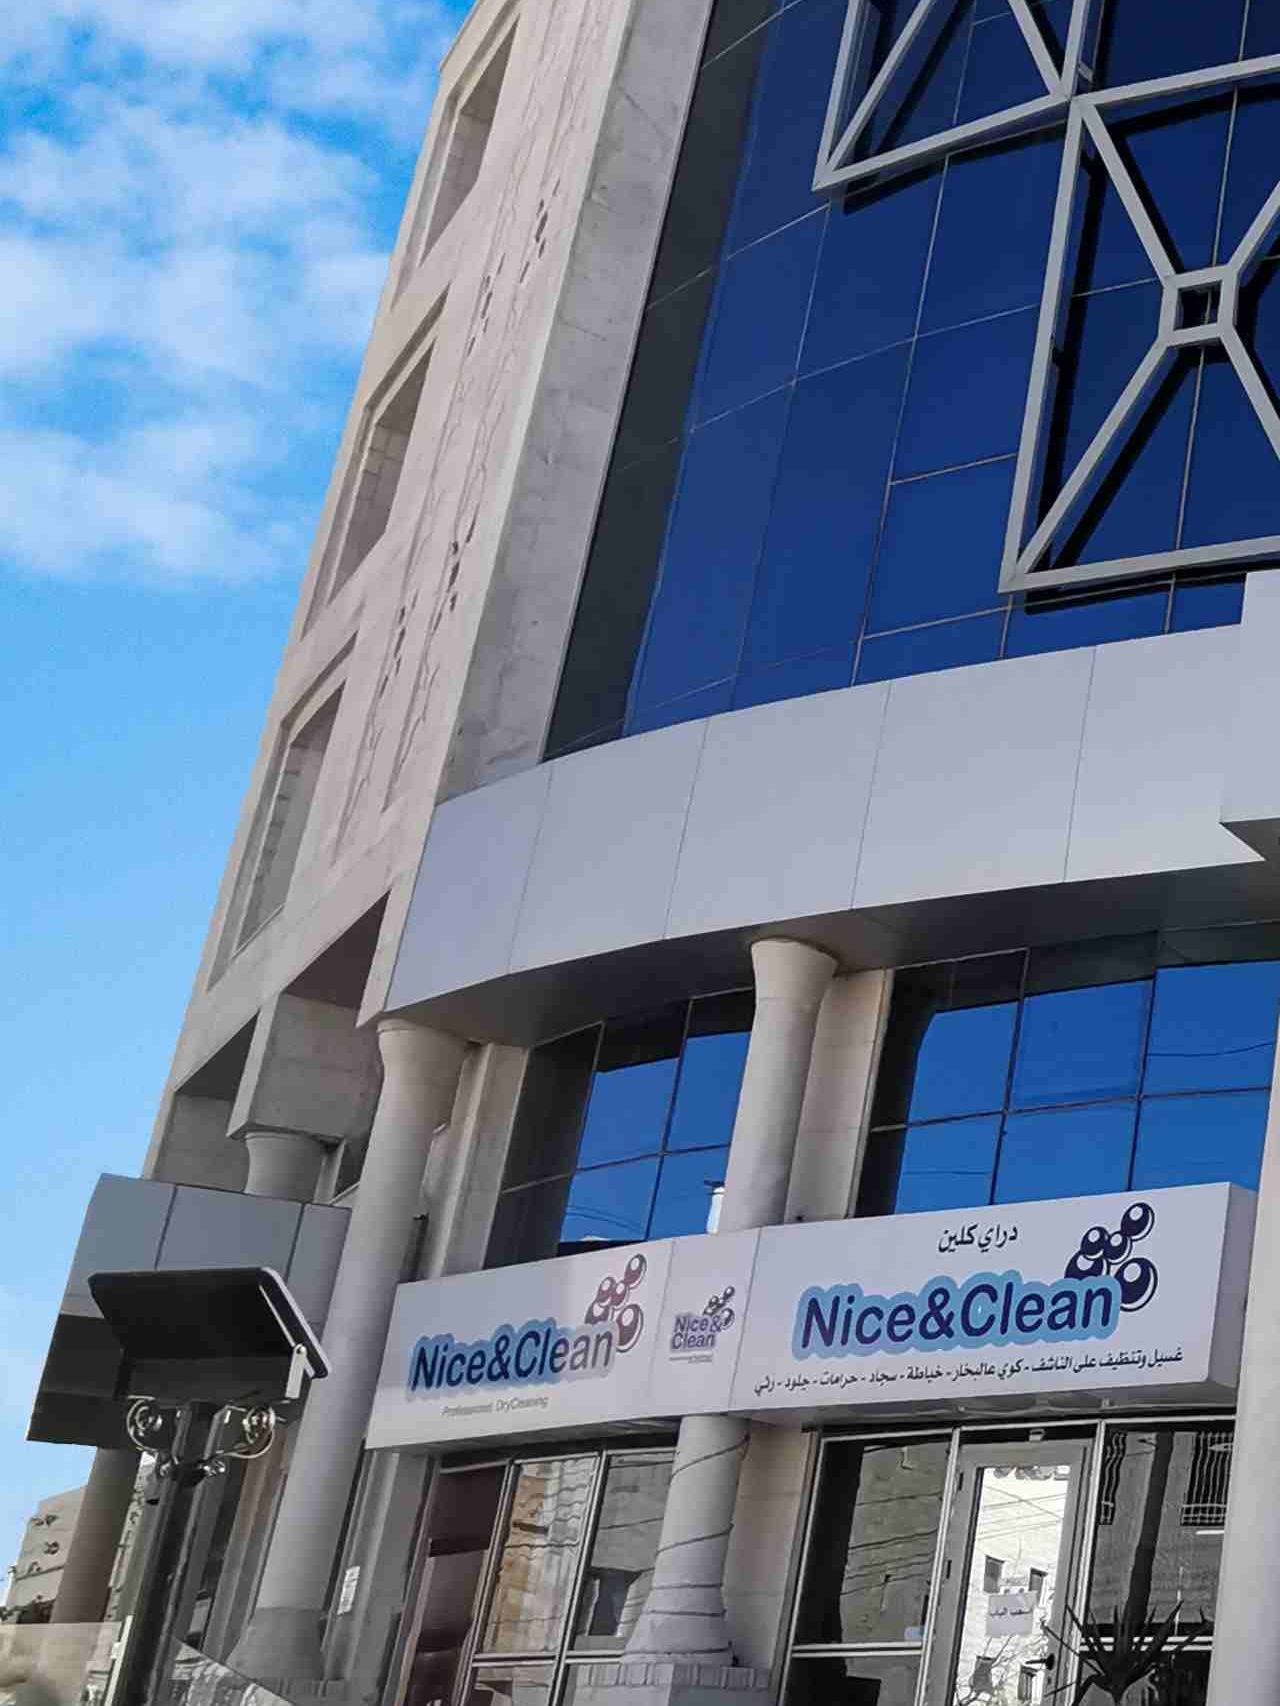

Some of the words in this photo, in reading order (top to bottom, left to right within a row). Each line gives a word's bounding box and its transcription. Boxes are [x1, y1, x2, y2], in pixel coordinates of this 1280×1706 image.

[938, 1223, 978, 1253] كلين
[977, 1223, 1018, 1253] دراي
[802, 1280, 1111, 1349] Nice&Clean
[671, 1333, 716, 1350] Clean
[411, 1327, 614, 1391] Nice&Clean
[1099, 1349, 1147, 1371] وتنظيف
[1147, 1346, 1184, 1368] غسيل
[784, 1373, 810, 1391] جلود
[819, 1370, 859, 1389] حرامات
[868, 1366, 898, 1386] سجاد
[906, 1364, 943, 1384] خياطة
